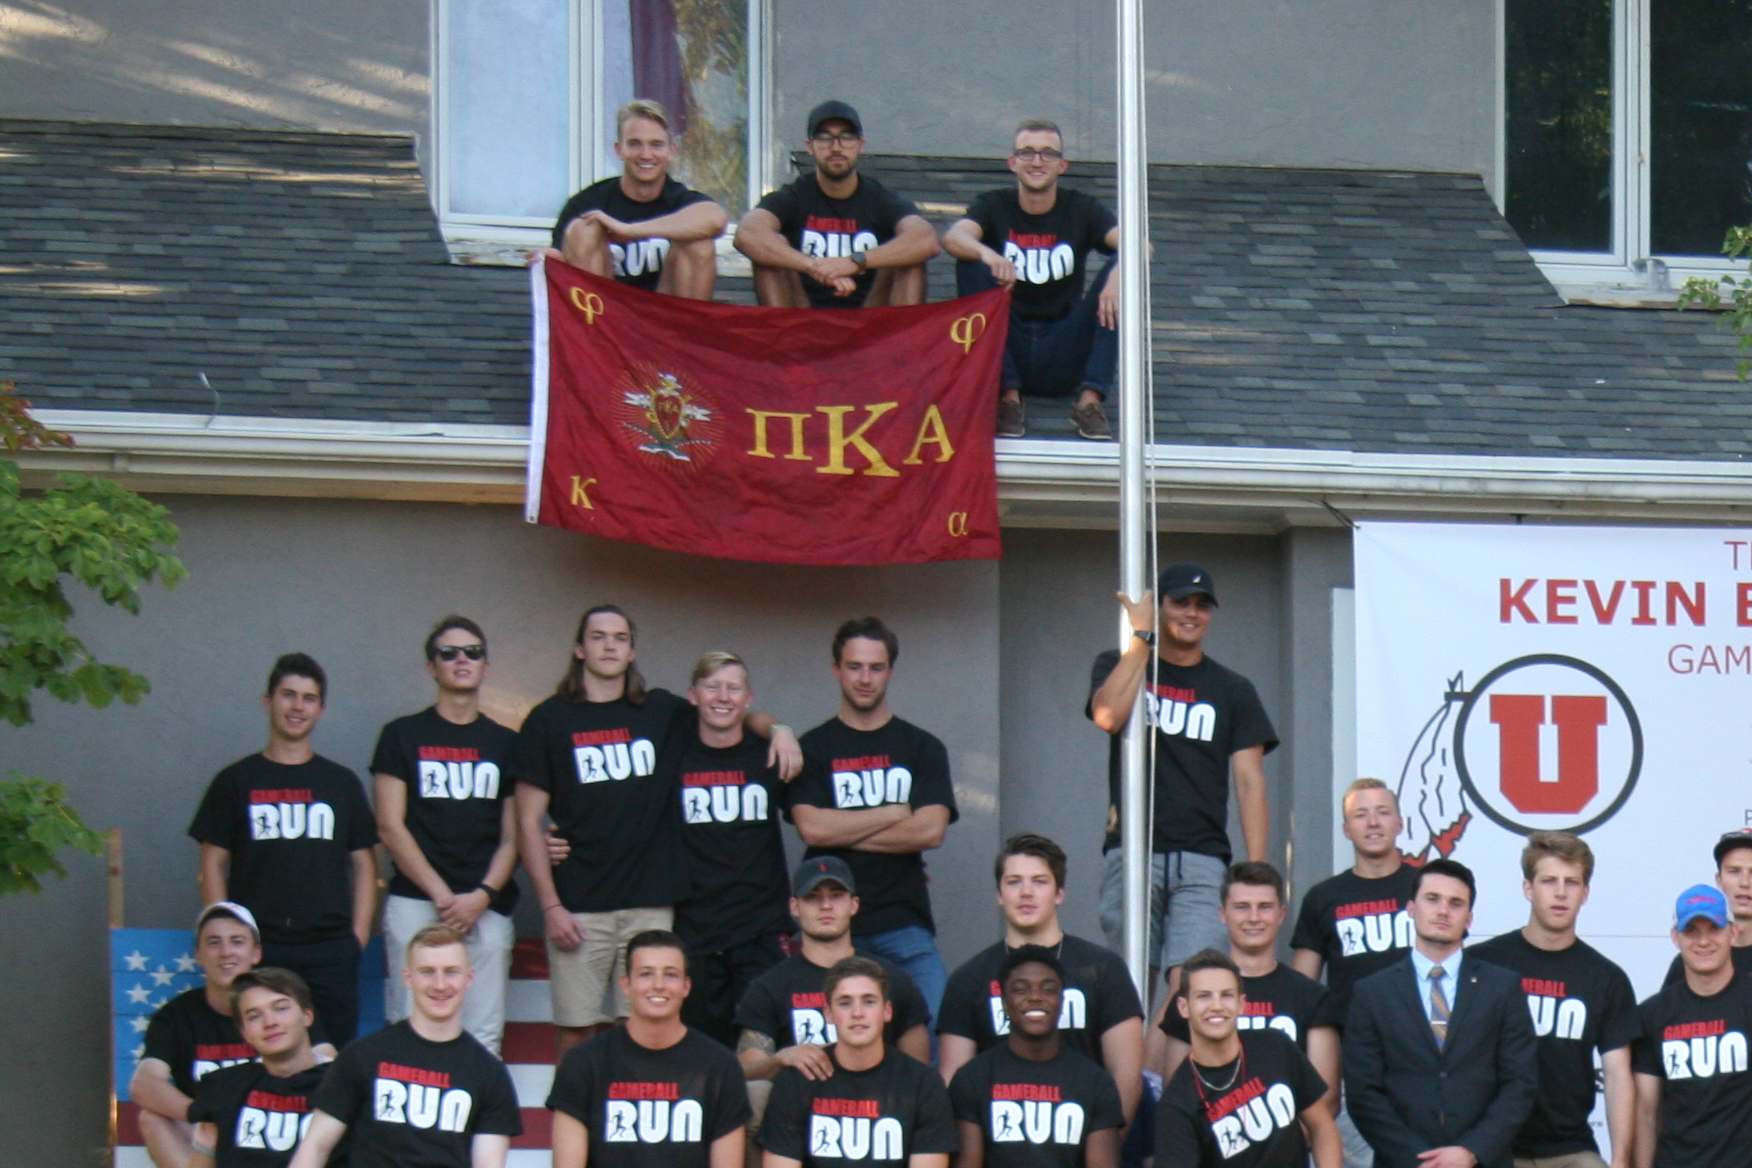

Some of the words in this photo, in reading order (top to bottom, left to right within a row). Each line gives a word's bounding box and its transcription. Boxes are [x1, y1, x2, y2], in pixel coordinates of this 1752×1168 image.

[1004, 240, 1074, 284] RUN
[1498, 577, 1707, 627] KEVIN
[418, 745, 480, 762] GAMEBALL
[572, 728, 633, 746] GAMEBALL
[1489, 694, 1608, 814] U
[418, 760, 500, 800] RUN
[574, 739, 656, 784] RUN
[683, 771, 746, 787] GAMEBALL
[832, 755, 893, 773] GAMEBALL
[250, 788, 313, 803] GAMEBALL
[683, 783, 768, 824] RUN
[832, 767, 912, 809] RUN
[249, 803, 335, 841] RUN
[1336, 897, 1400, 917] GAMEBALL
[1336, 910, 1416, 958] RUN
[1528, 995, 1588, 1040] UN
[1663, 1019, 1726, 1041] GAMEBALL
[378, 1062, 451, 1089] GAMEBALL
[1662, 1030, 1748, 1080] RUN
[374, 1078, 473, 1133] RUN
[608, 1083, 680, 1100] GAMEBALL
[812, 1098, 880, 1119] GAMEBALL
[992, 1084, 1061, 1101] GAMEBALL
[605, 1099, 703, 1143] RUN
[808, 1116, 904, 1161] RUN
[991, 1100, 1085, 1145] RUN
[1211, 1083, 1296, 1160] RUN
